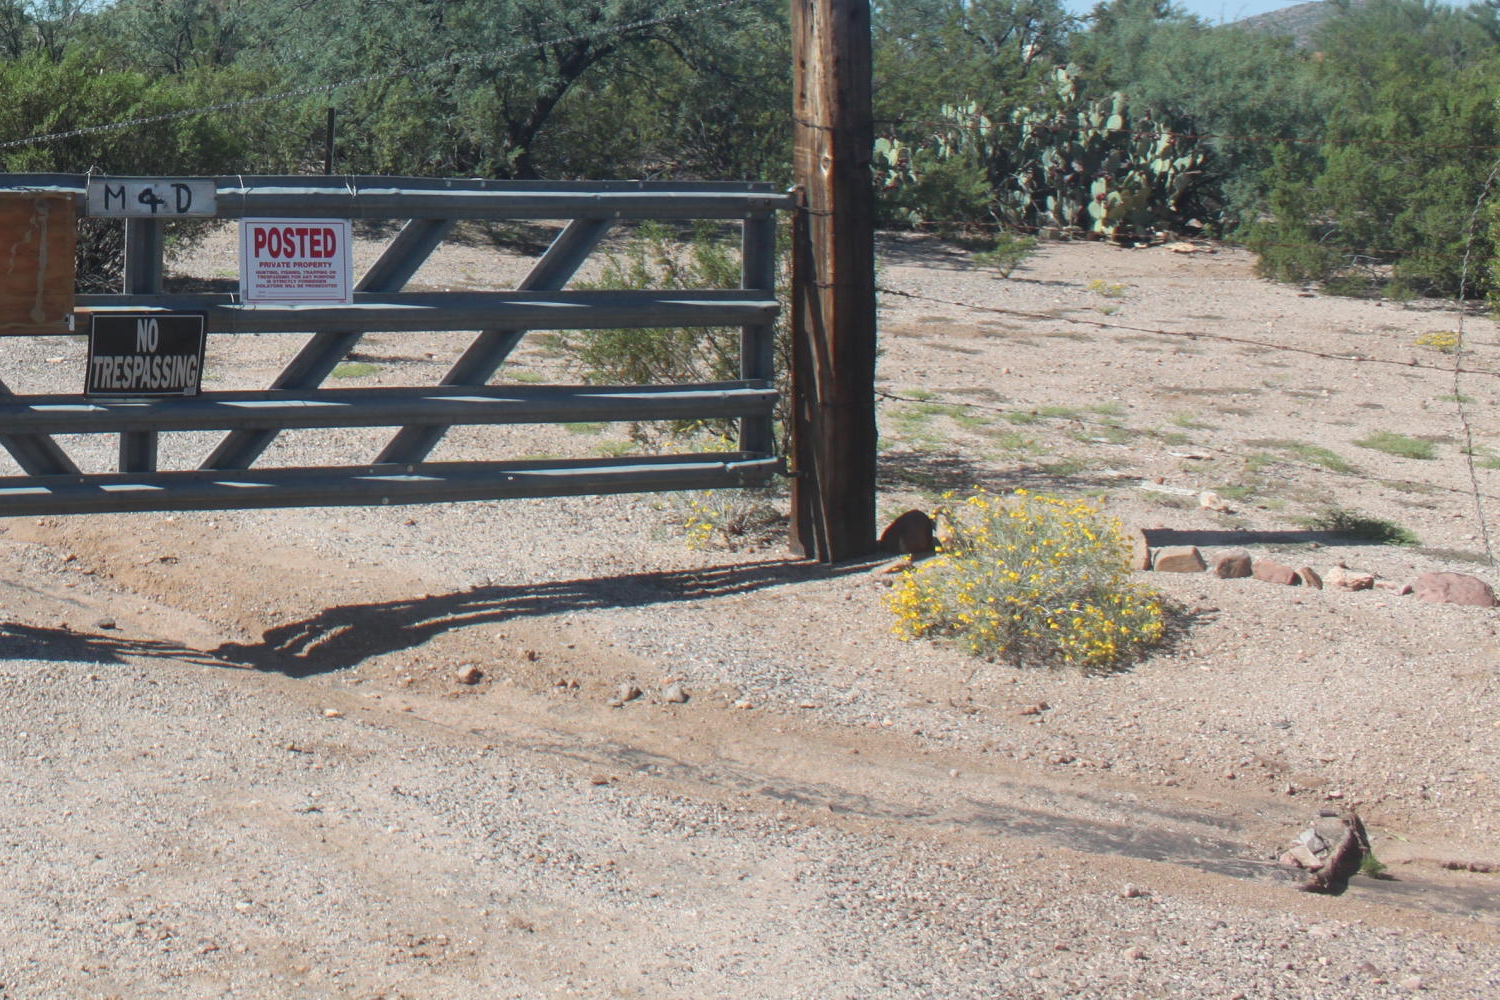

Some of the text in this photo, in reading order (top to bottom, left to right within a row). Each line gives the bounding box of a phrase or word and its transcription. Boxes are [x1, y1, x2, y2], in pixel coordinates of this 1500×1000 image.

[254, 227, 337, 259] POSTED
[136, 318, 159, 353] NO
[93, 354, 197, 389] TRESPASSING
